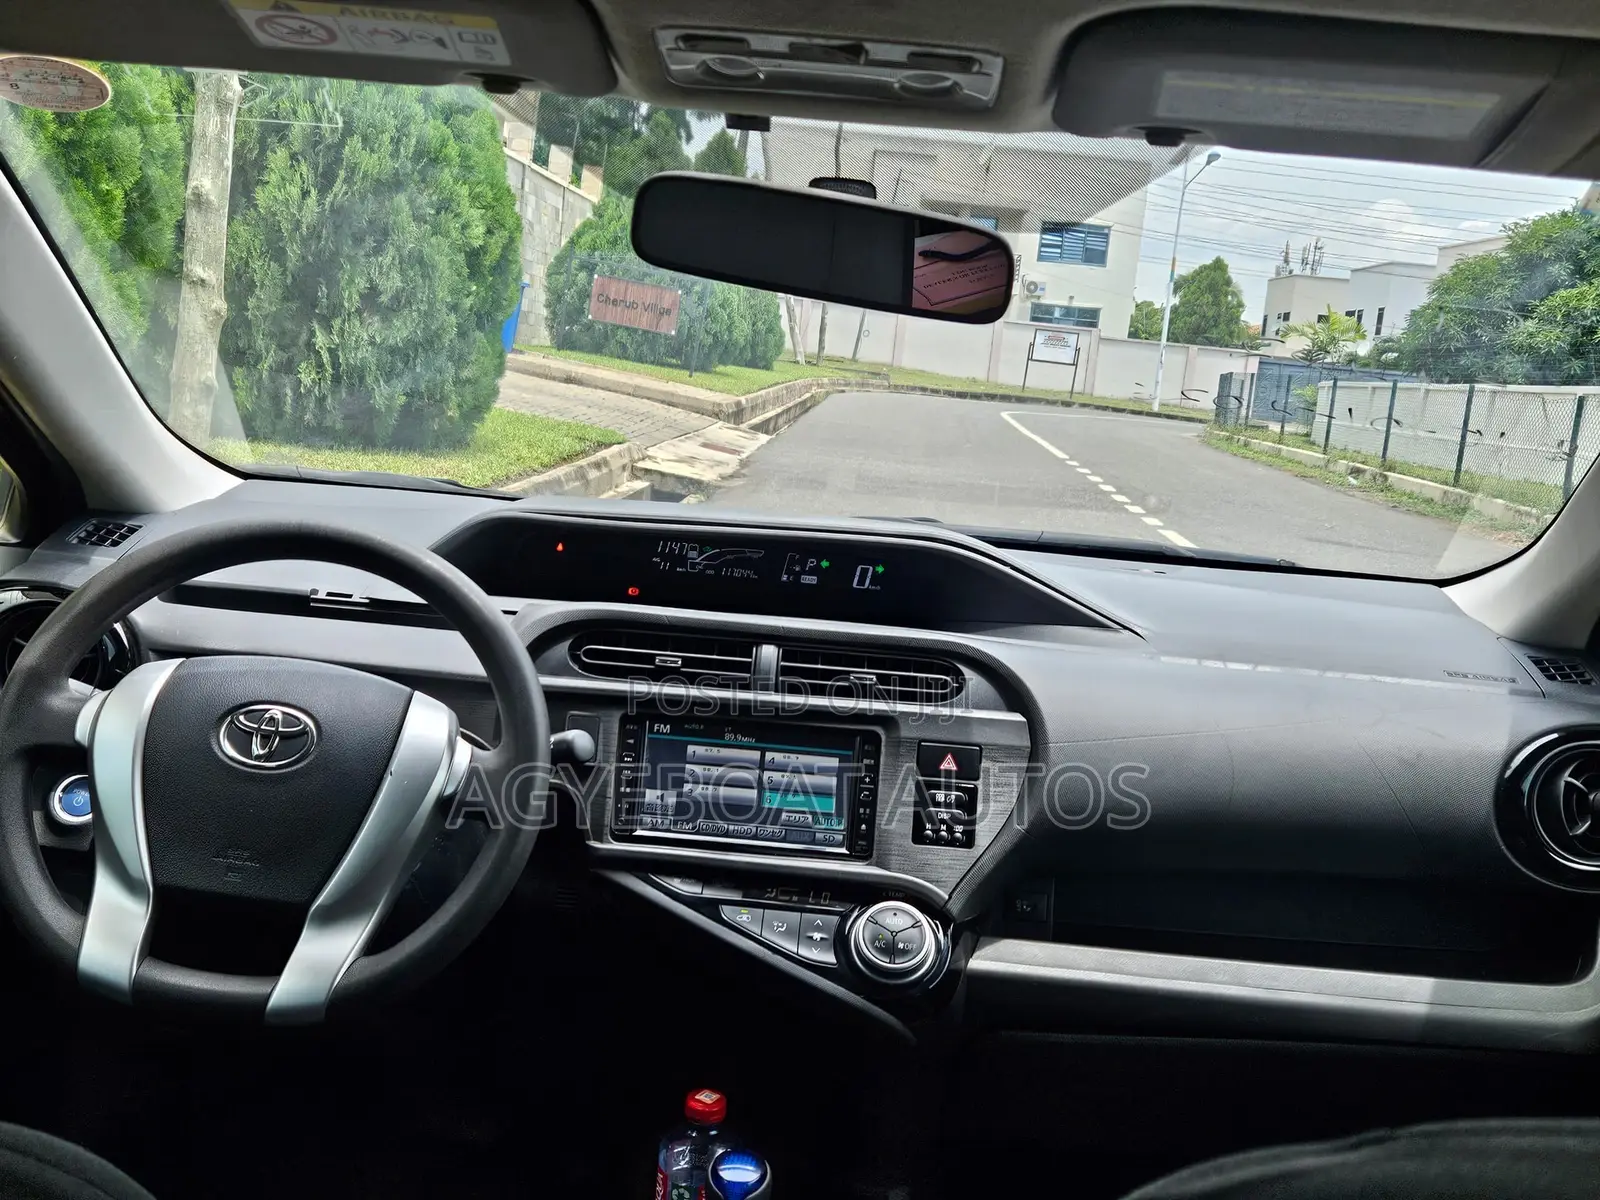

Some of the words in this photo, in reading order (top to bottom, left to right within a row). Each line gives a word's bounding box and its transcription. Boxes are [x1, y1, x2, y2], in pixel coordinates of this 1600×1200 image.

[338, 5, 454, 25] AIRBAG
[597, 293, 639, 309] Cherub
[806, 559, 817, 571] P
[852, 565, 873, 589] 0
[653, 723, 671, 734] FM
[768, 756, 775, 765] 4
[767, 774, 775, 785] 5
[73, 788, 90, 797] POWE
[647, 818, 665, 829] AM
[677, 821, 693, 831] FM
[701, 823, 726, 834] CD/DVD
[732, 826, 753, 837] HDD
[823, 834, 836, 844] SD
[885, 917, 903, 926] AUTO
[904, 942, 917, 950] OFF
